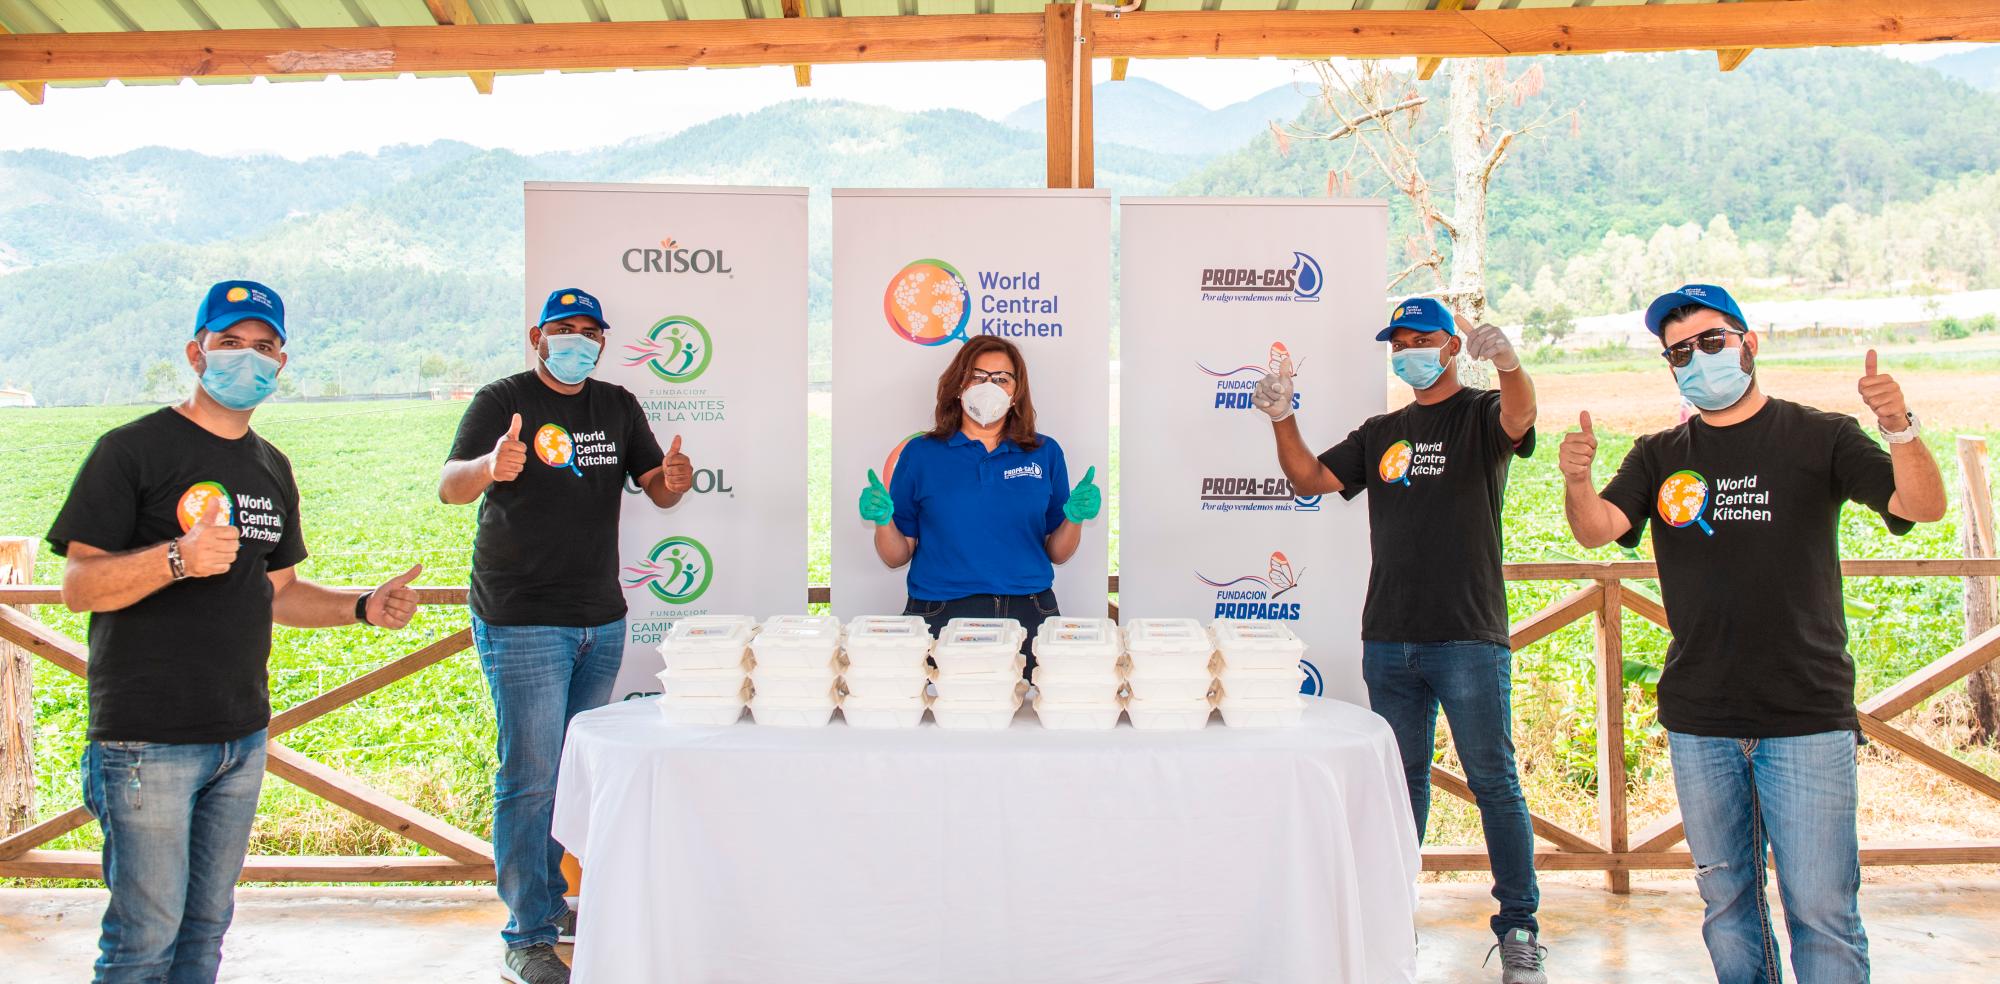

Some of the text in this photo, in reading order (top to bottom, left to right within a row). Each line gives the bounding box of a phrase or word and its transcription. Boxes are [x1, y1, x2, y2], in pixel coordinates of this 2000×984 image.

[622, 248, 732, 274] CRISOL
[978, 271, 1040, 290] World
[1201, 269, 1297, 290] PROPA-GAS
[981, 295, 1058, 314] Central
[1202, 293, 1292, 303] Por algo vendemos más
[981, 318, 1063, 337] Kitchen
[1217, 381, 1259, 390] FUNDACI
[641, 401, 725, 410] AMINANTES
[667, 412, 685, 422] LA
[691, 412, 725, 422] VIDA
[572, 431, 606, 443] World
[575, 441, 616, 455] Central
[577, 454, 618, 467] Kitchen
[1413, 454, 1446, 465] Centra
[1716, 474, 1758, 491] World
[236, 494, 273, 511] World
[1715, 491, 1769, 506] Central
[1202, 502, 1292, 512] Por algo vendemos más
[1712, 507, 1772, 522] Kitchen
[1217, 591, 1267, 600] FUNDACION
[1215, 603, 1301, 620] PROPAGAS
[632, 634, 662, 644] POR
